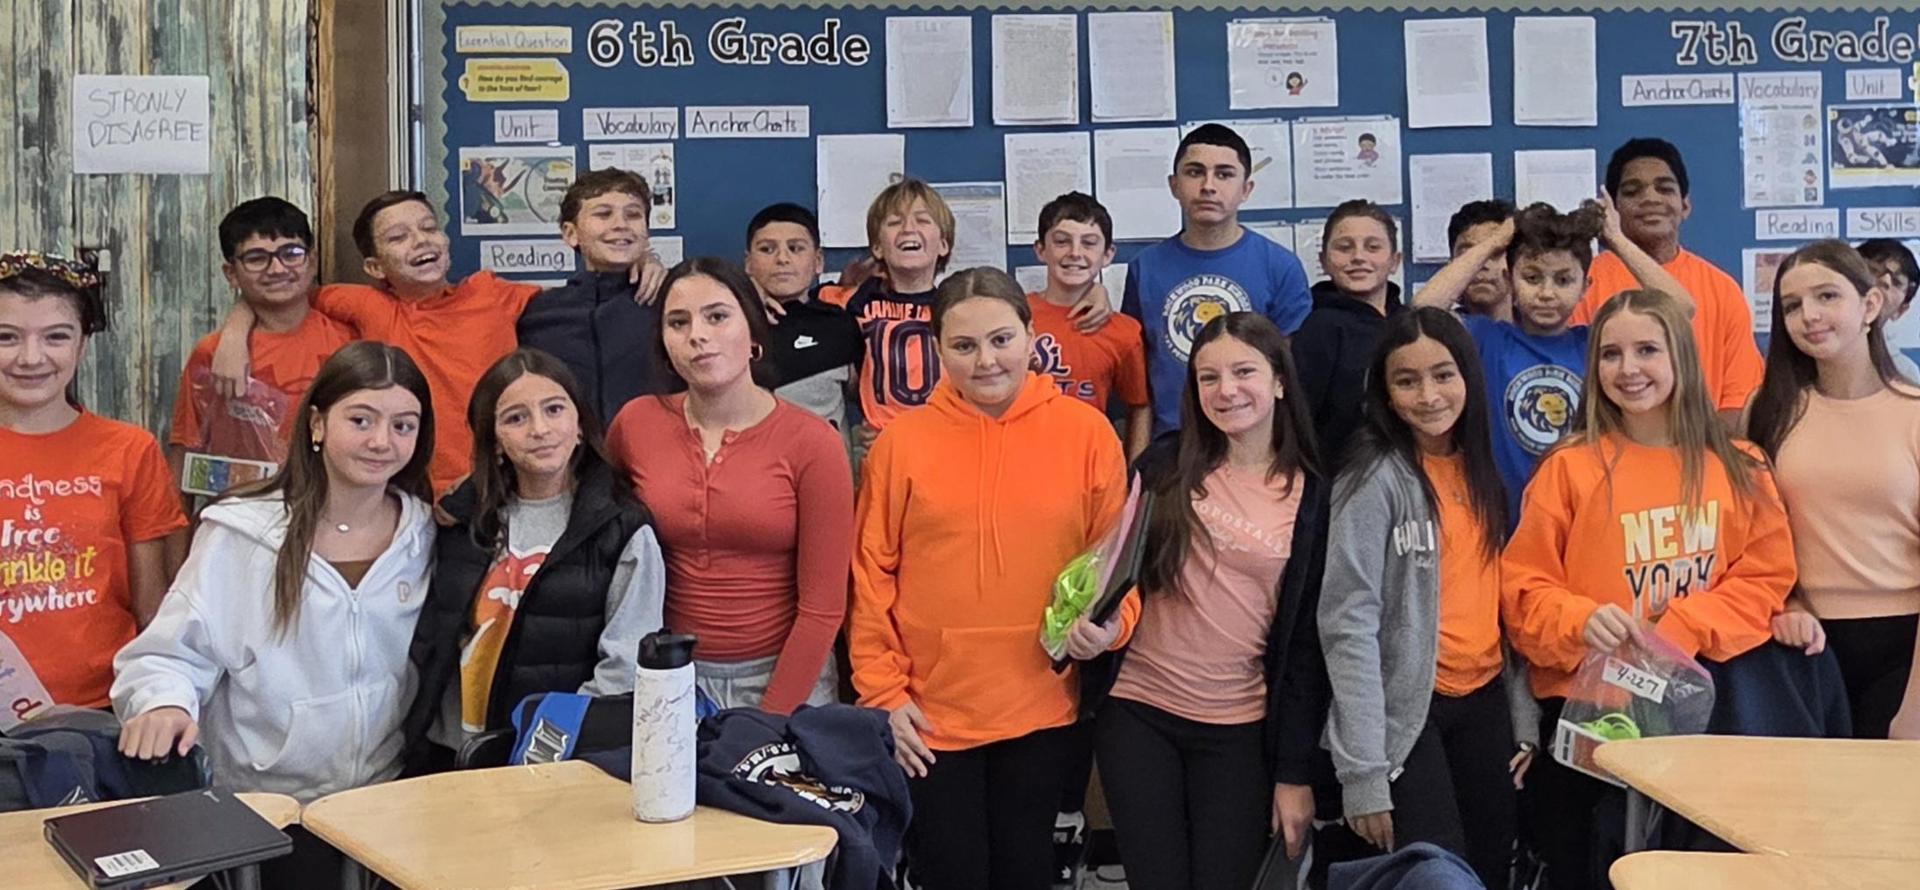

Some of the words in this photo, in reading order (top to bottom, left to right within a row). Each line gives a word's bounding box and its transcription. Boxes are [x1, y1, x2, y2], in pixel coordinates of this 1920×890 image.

[514, 31, 568, 49] Question
[588, 18, 693, 67] 6th
[709, 16, 870, 67] Grade
[1672, 20, 1757, 65] 7th
[1772, 16, 1915, 63] Grade
[1743, 77, 1819, 99] Vocabulary
[1852, 74, 1885, 96] Unit
[88, 117, 203, 148] DISAGREE
[501, 114, 540, 138] Unit
[597, 112, 676, 139] Vocabulary
[692, 110, 751, 134] Anchor
[1768, 213, 1834, 235] Reading
[491, 245, 566, 270] Reading
[863, 319, 942, 408] 10
[24, 504, 41, 521] is
[1620, 500, 1719, 565] NEW
[1625, 552, 1716, 622] YORK
